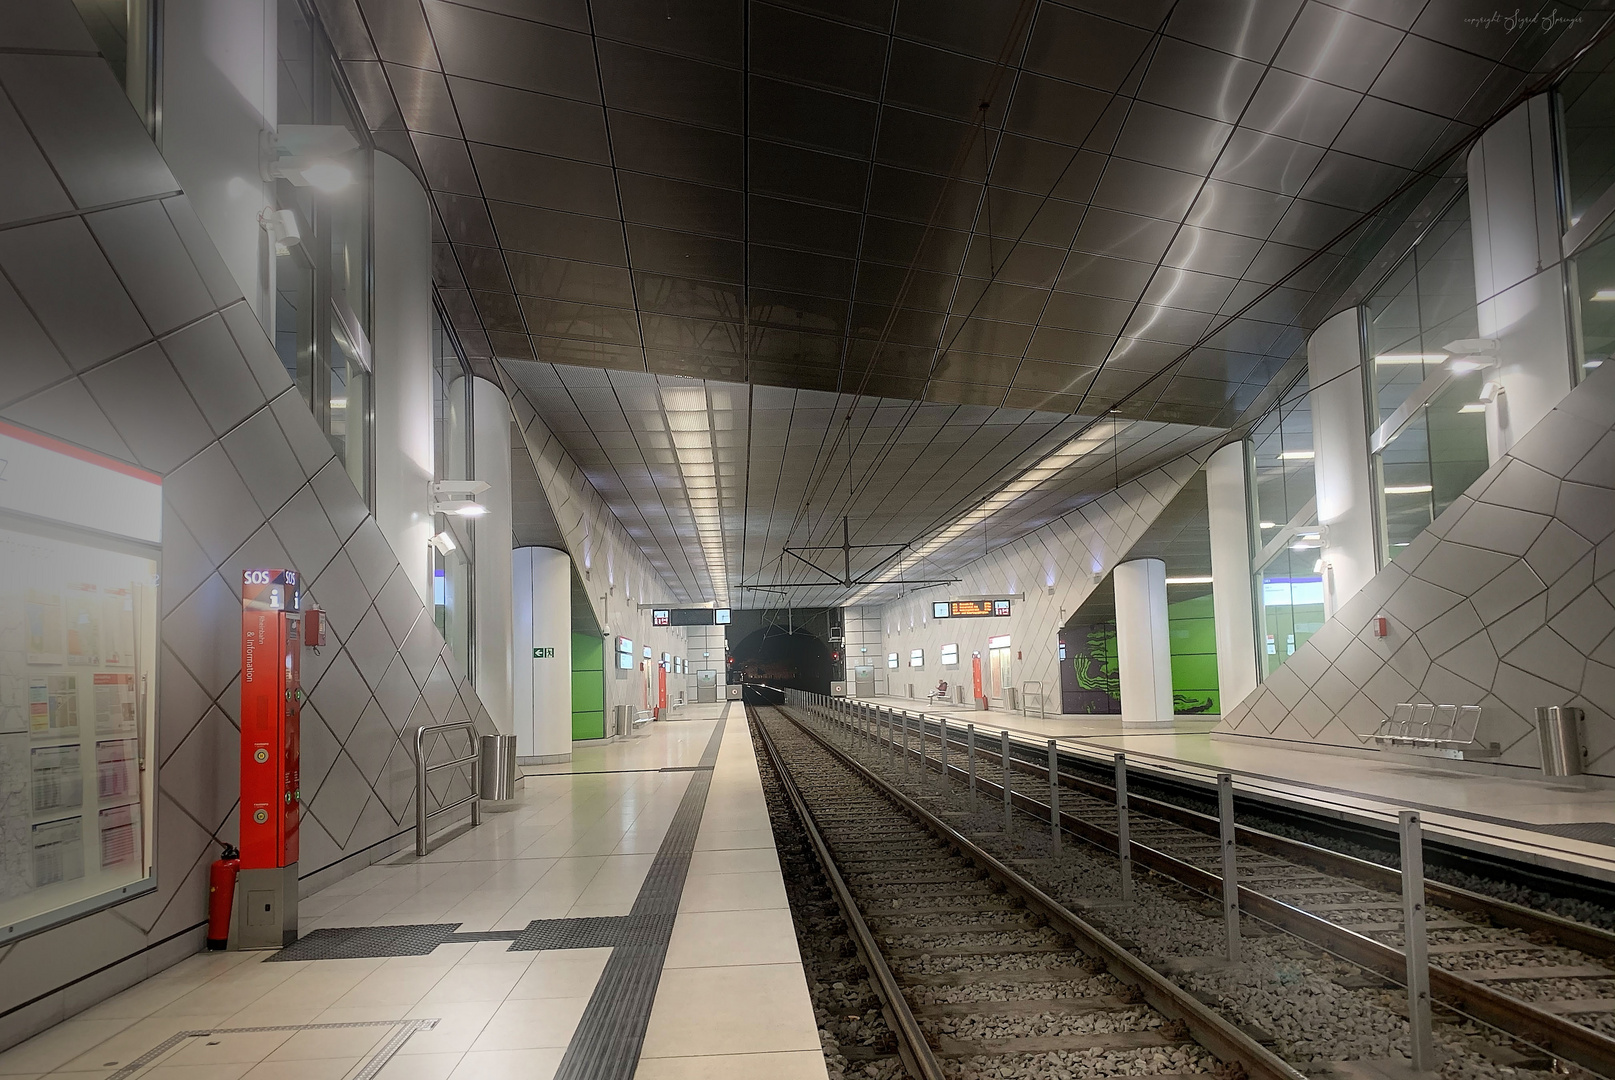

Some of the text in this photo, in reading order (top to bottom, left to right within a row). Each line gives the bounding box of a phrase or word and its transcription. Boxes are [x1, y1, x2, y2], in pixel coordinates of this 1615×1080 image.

[244, 571, 269, 585] SOS
[285, 570, 295, 586] SOS
[246, 639, 255, 682] Information
